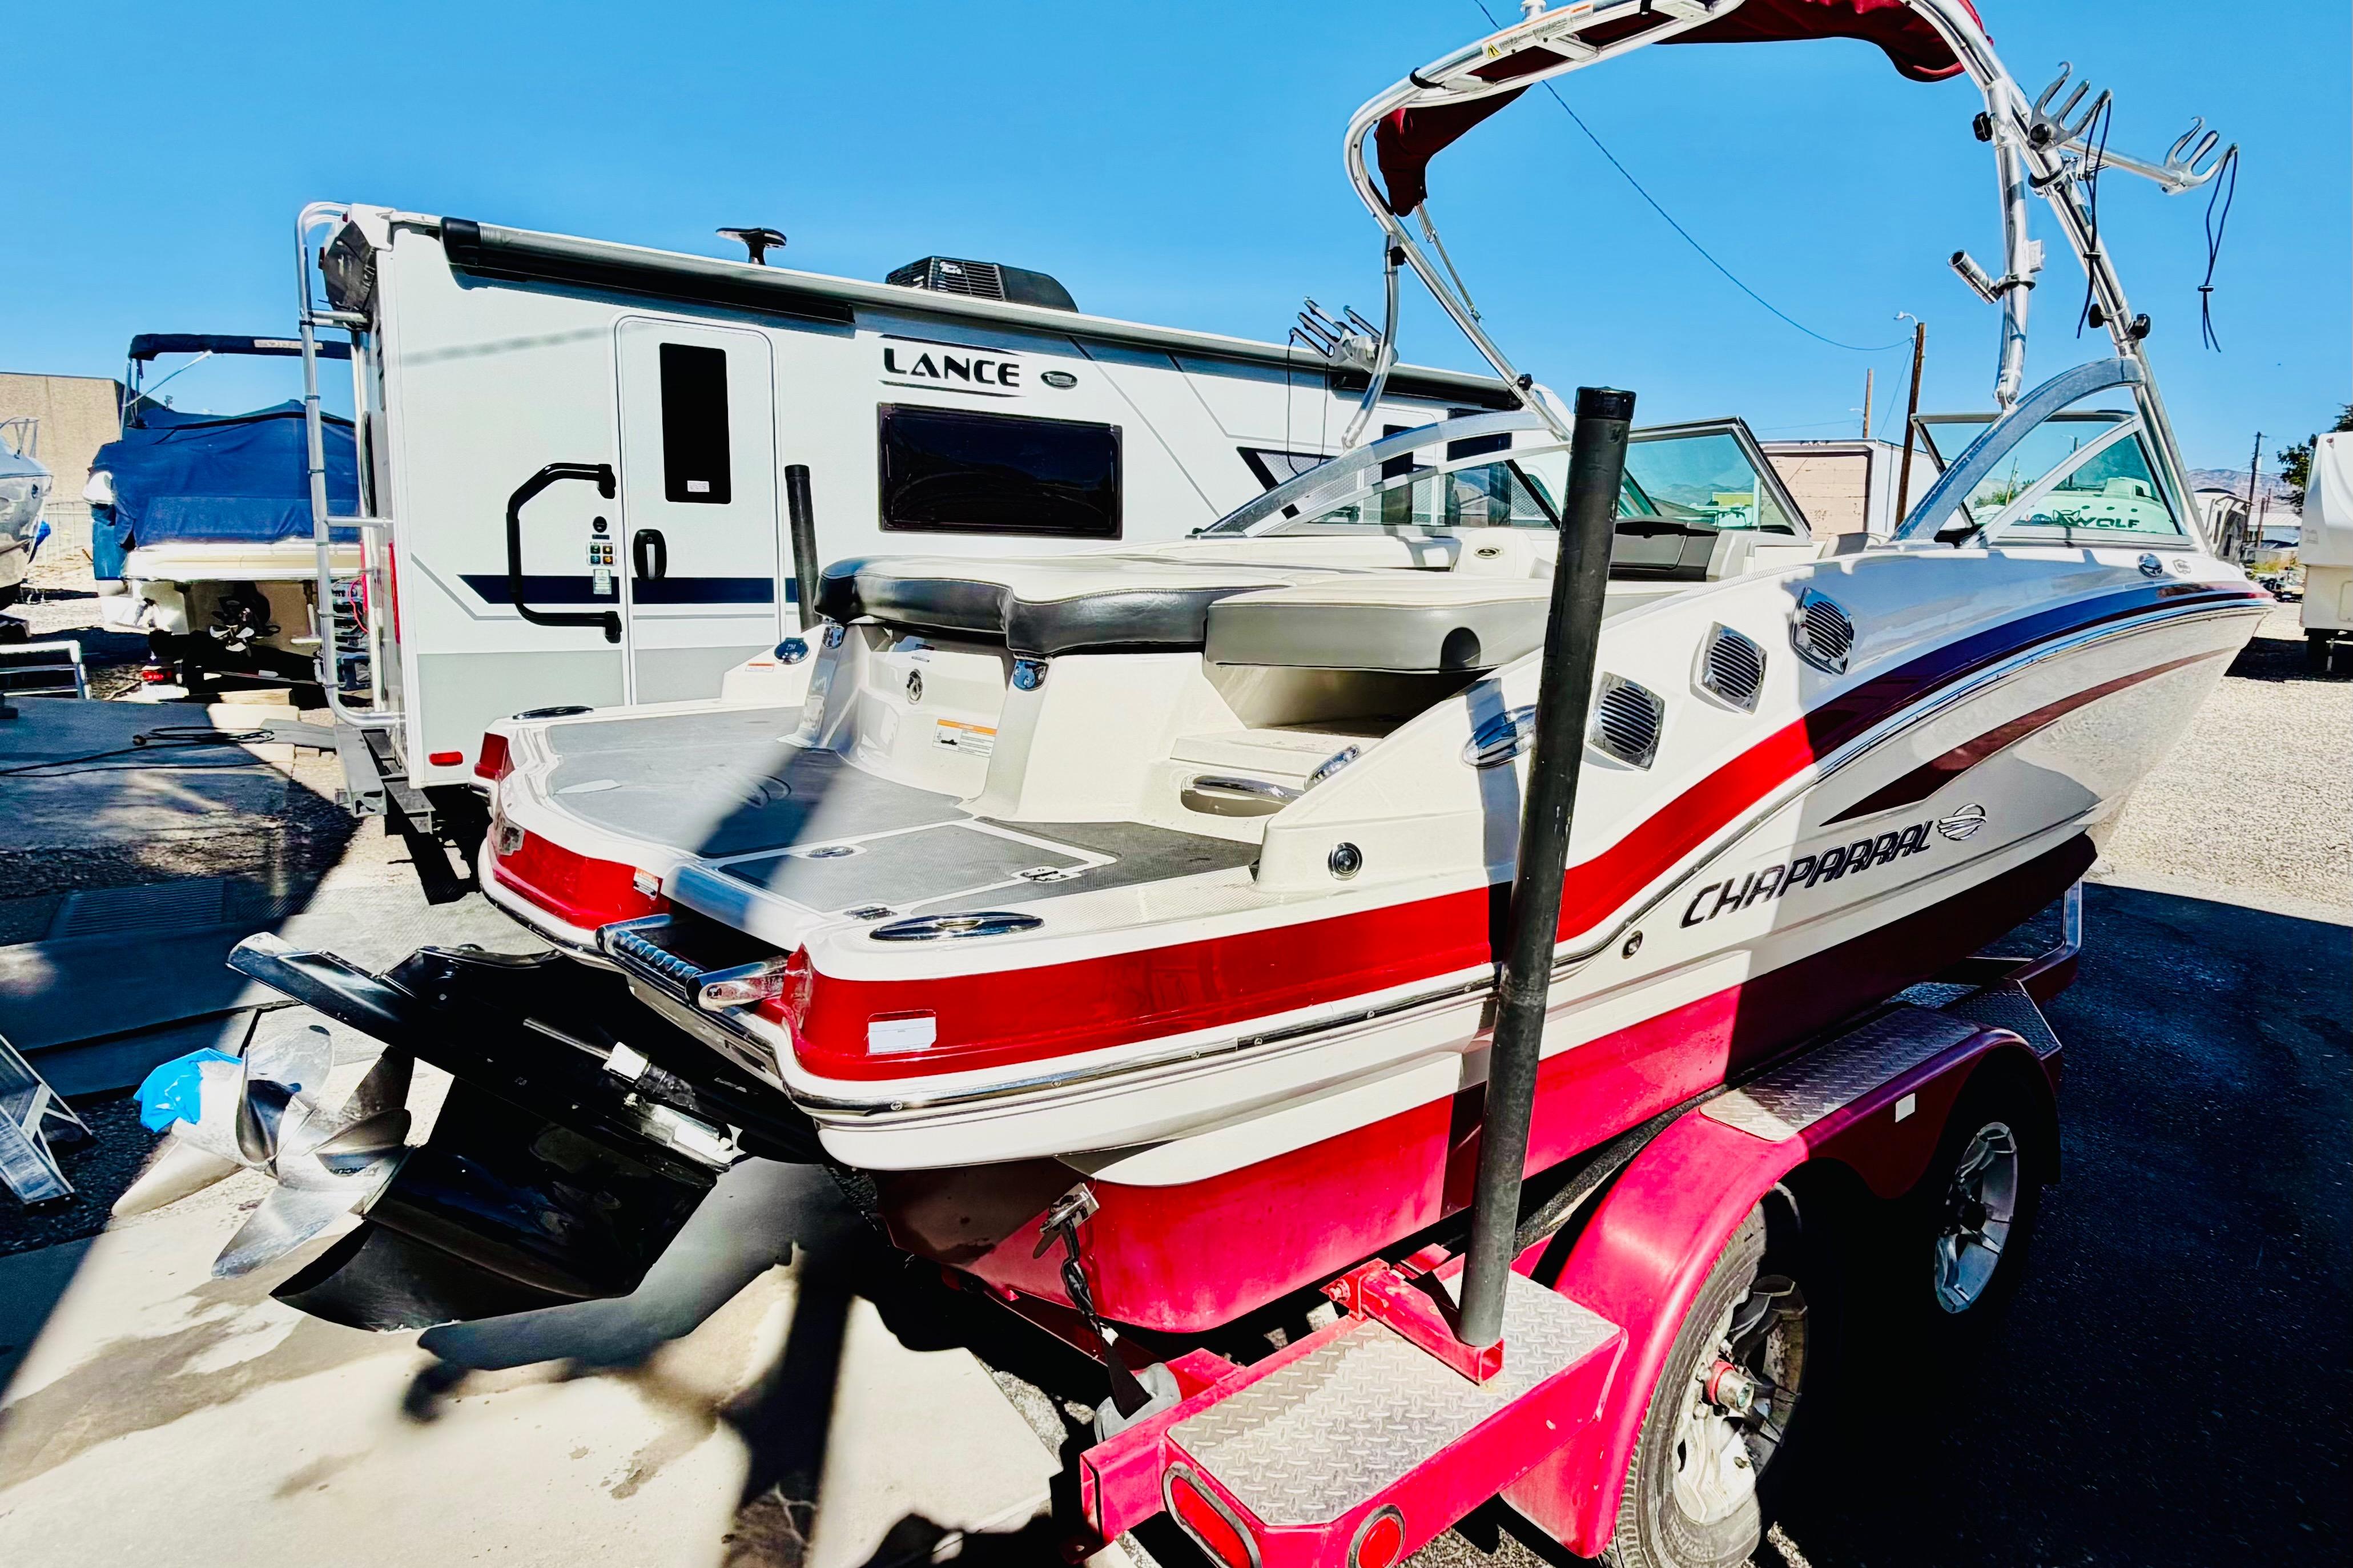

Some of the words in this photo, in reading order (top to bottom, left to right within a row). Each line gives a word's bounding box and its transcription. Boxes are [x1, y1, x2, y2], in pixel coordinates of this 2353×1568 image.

[884, 347, 1020, 388] LANCE
[2067, 517, 2140, 528] WOLF
[1679, 820, 1934, 929] CHAPARRAL
